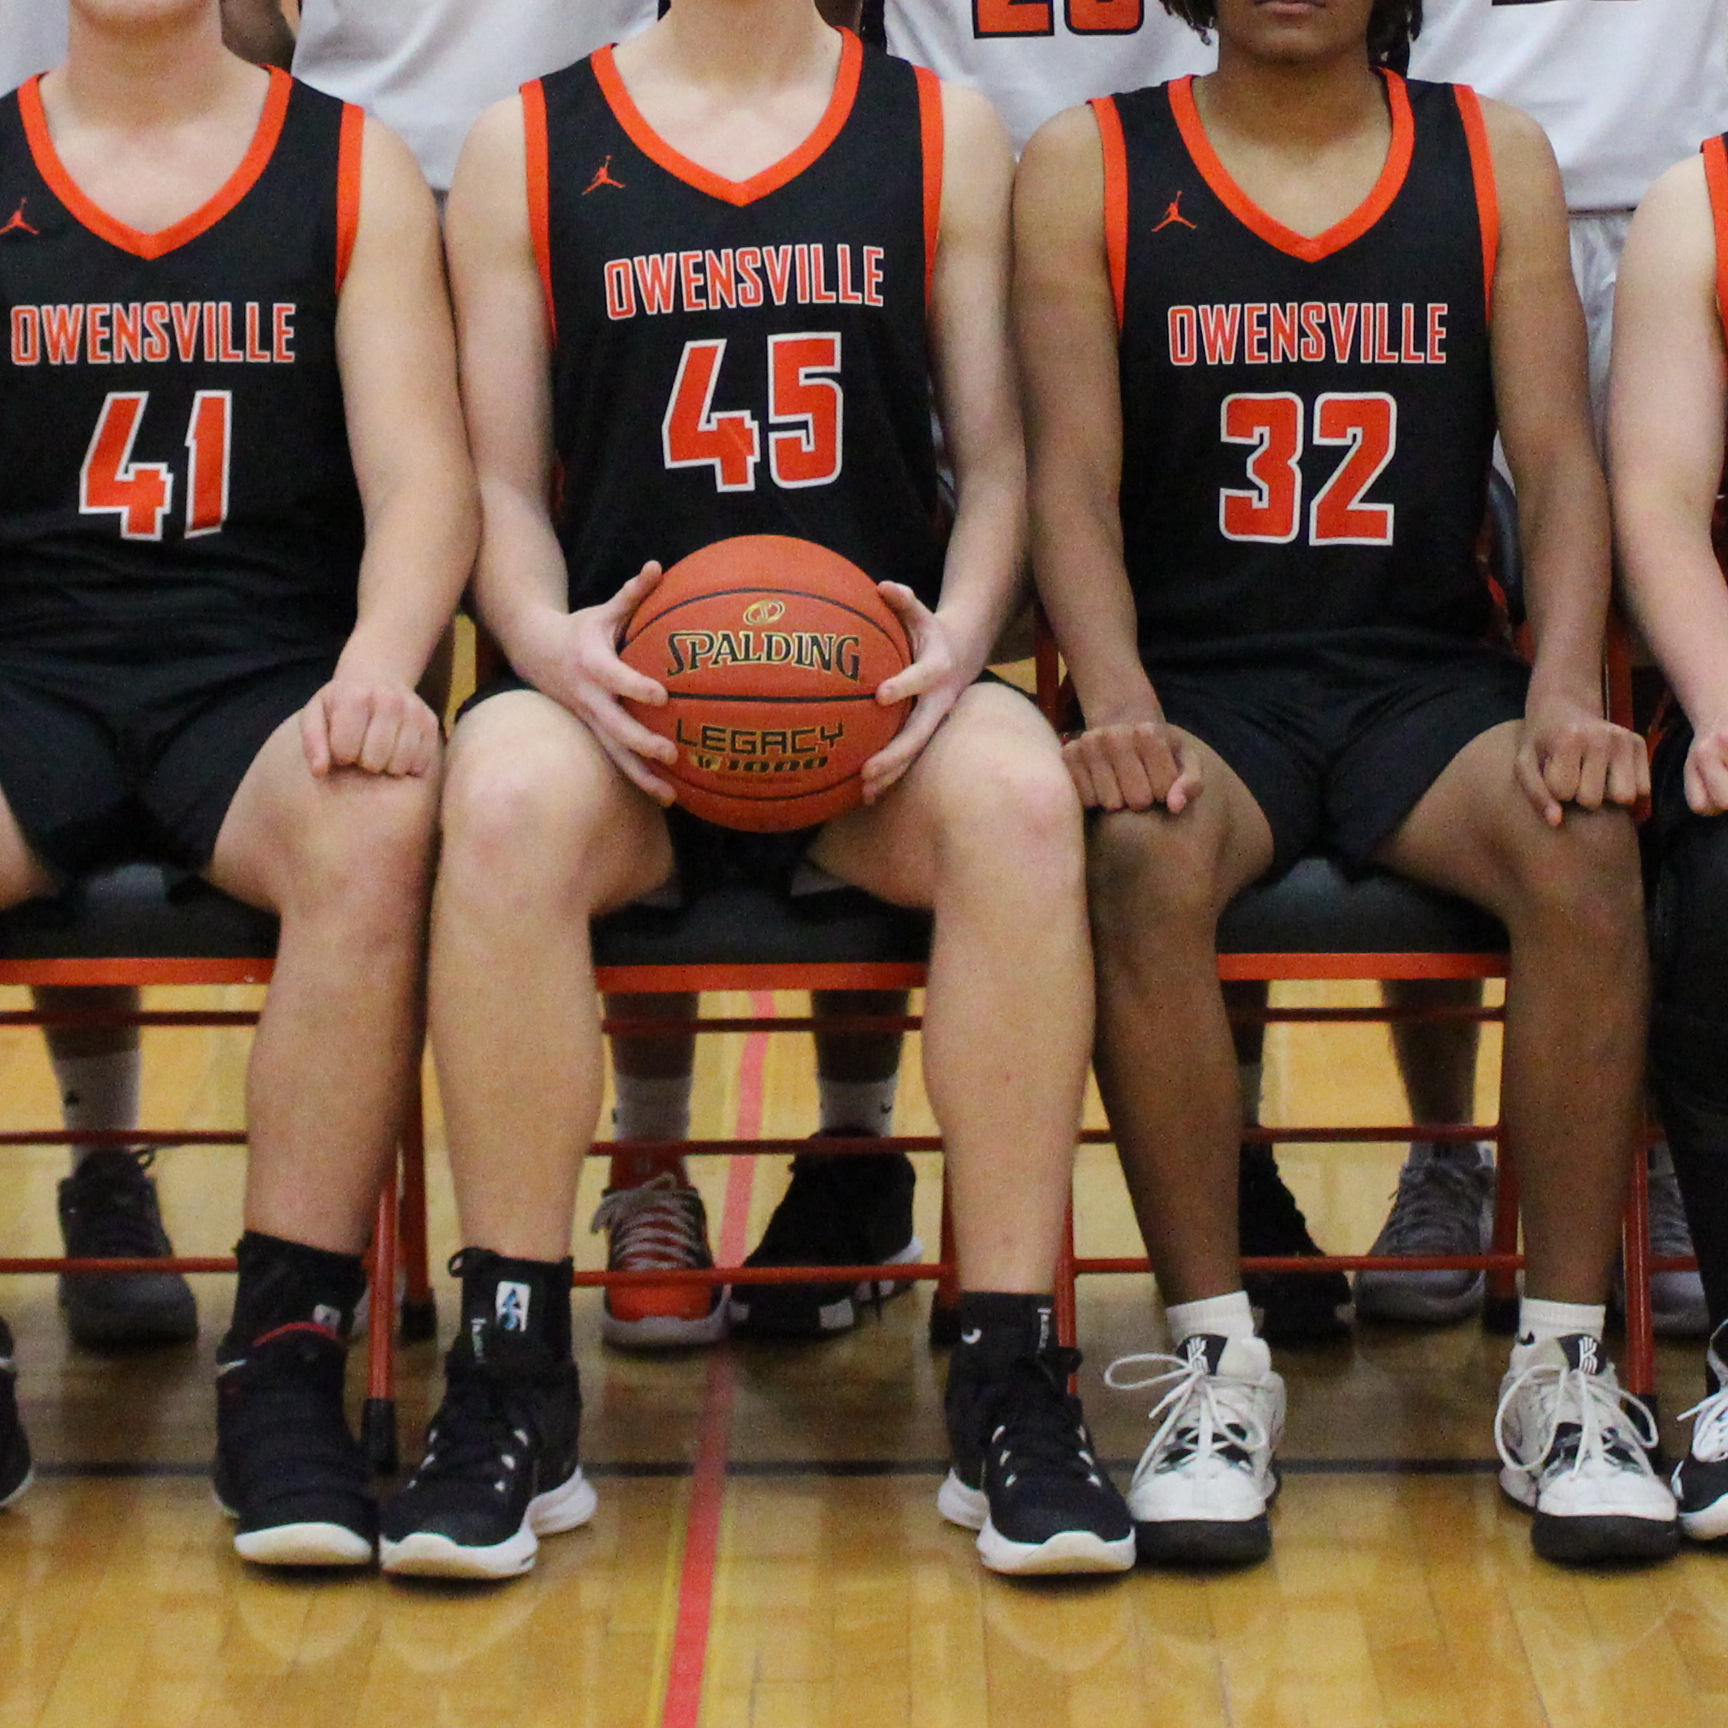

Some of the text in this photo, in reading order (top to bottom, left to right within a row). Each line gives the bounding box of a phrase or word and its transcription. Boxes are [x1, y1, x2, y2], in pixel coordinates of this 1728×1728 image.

[604, 244, 885, 321] OWENSVILLE
[10, 301, 296, 366] OWENSVILLE
[1167, 301, 1449, 366] OWENSVILLE
[662, 331, 845, 493] 45
[79, 390, 232, 542] 41
[1218, 391, 1399, 547] 32
[667, 629, 860, 684] SPALDING
[676, 718, 844, 756] LEGACY
